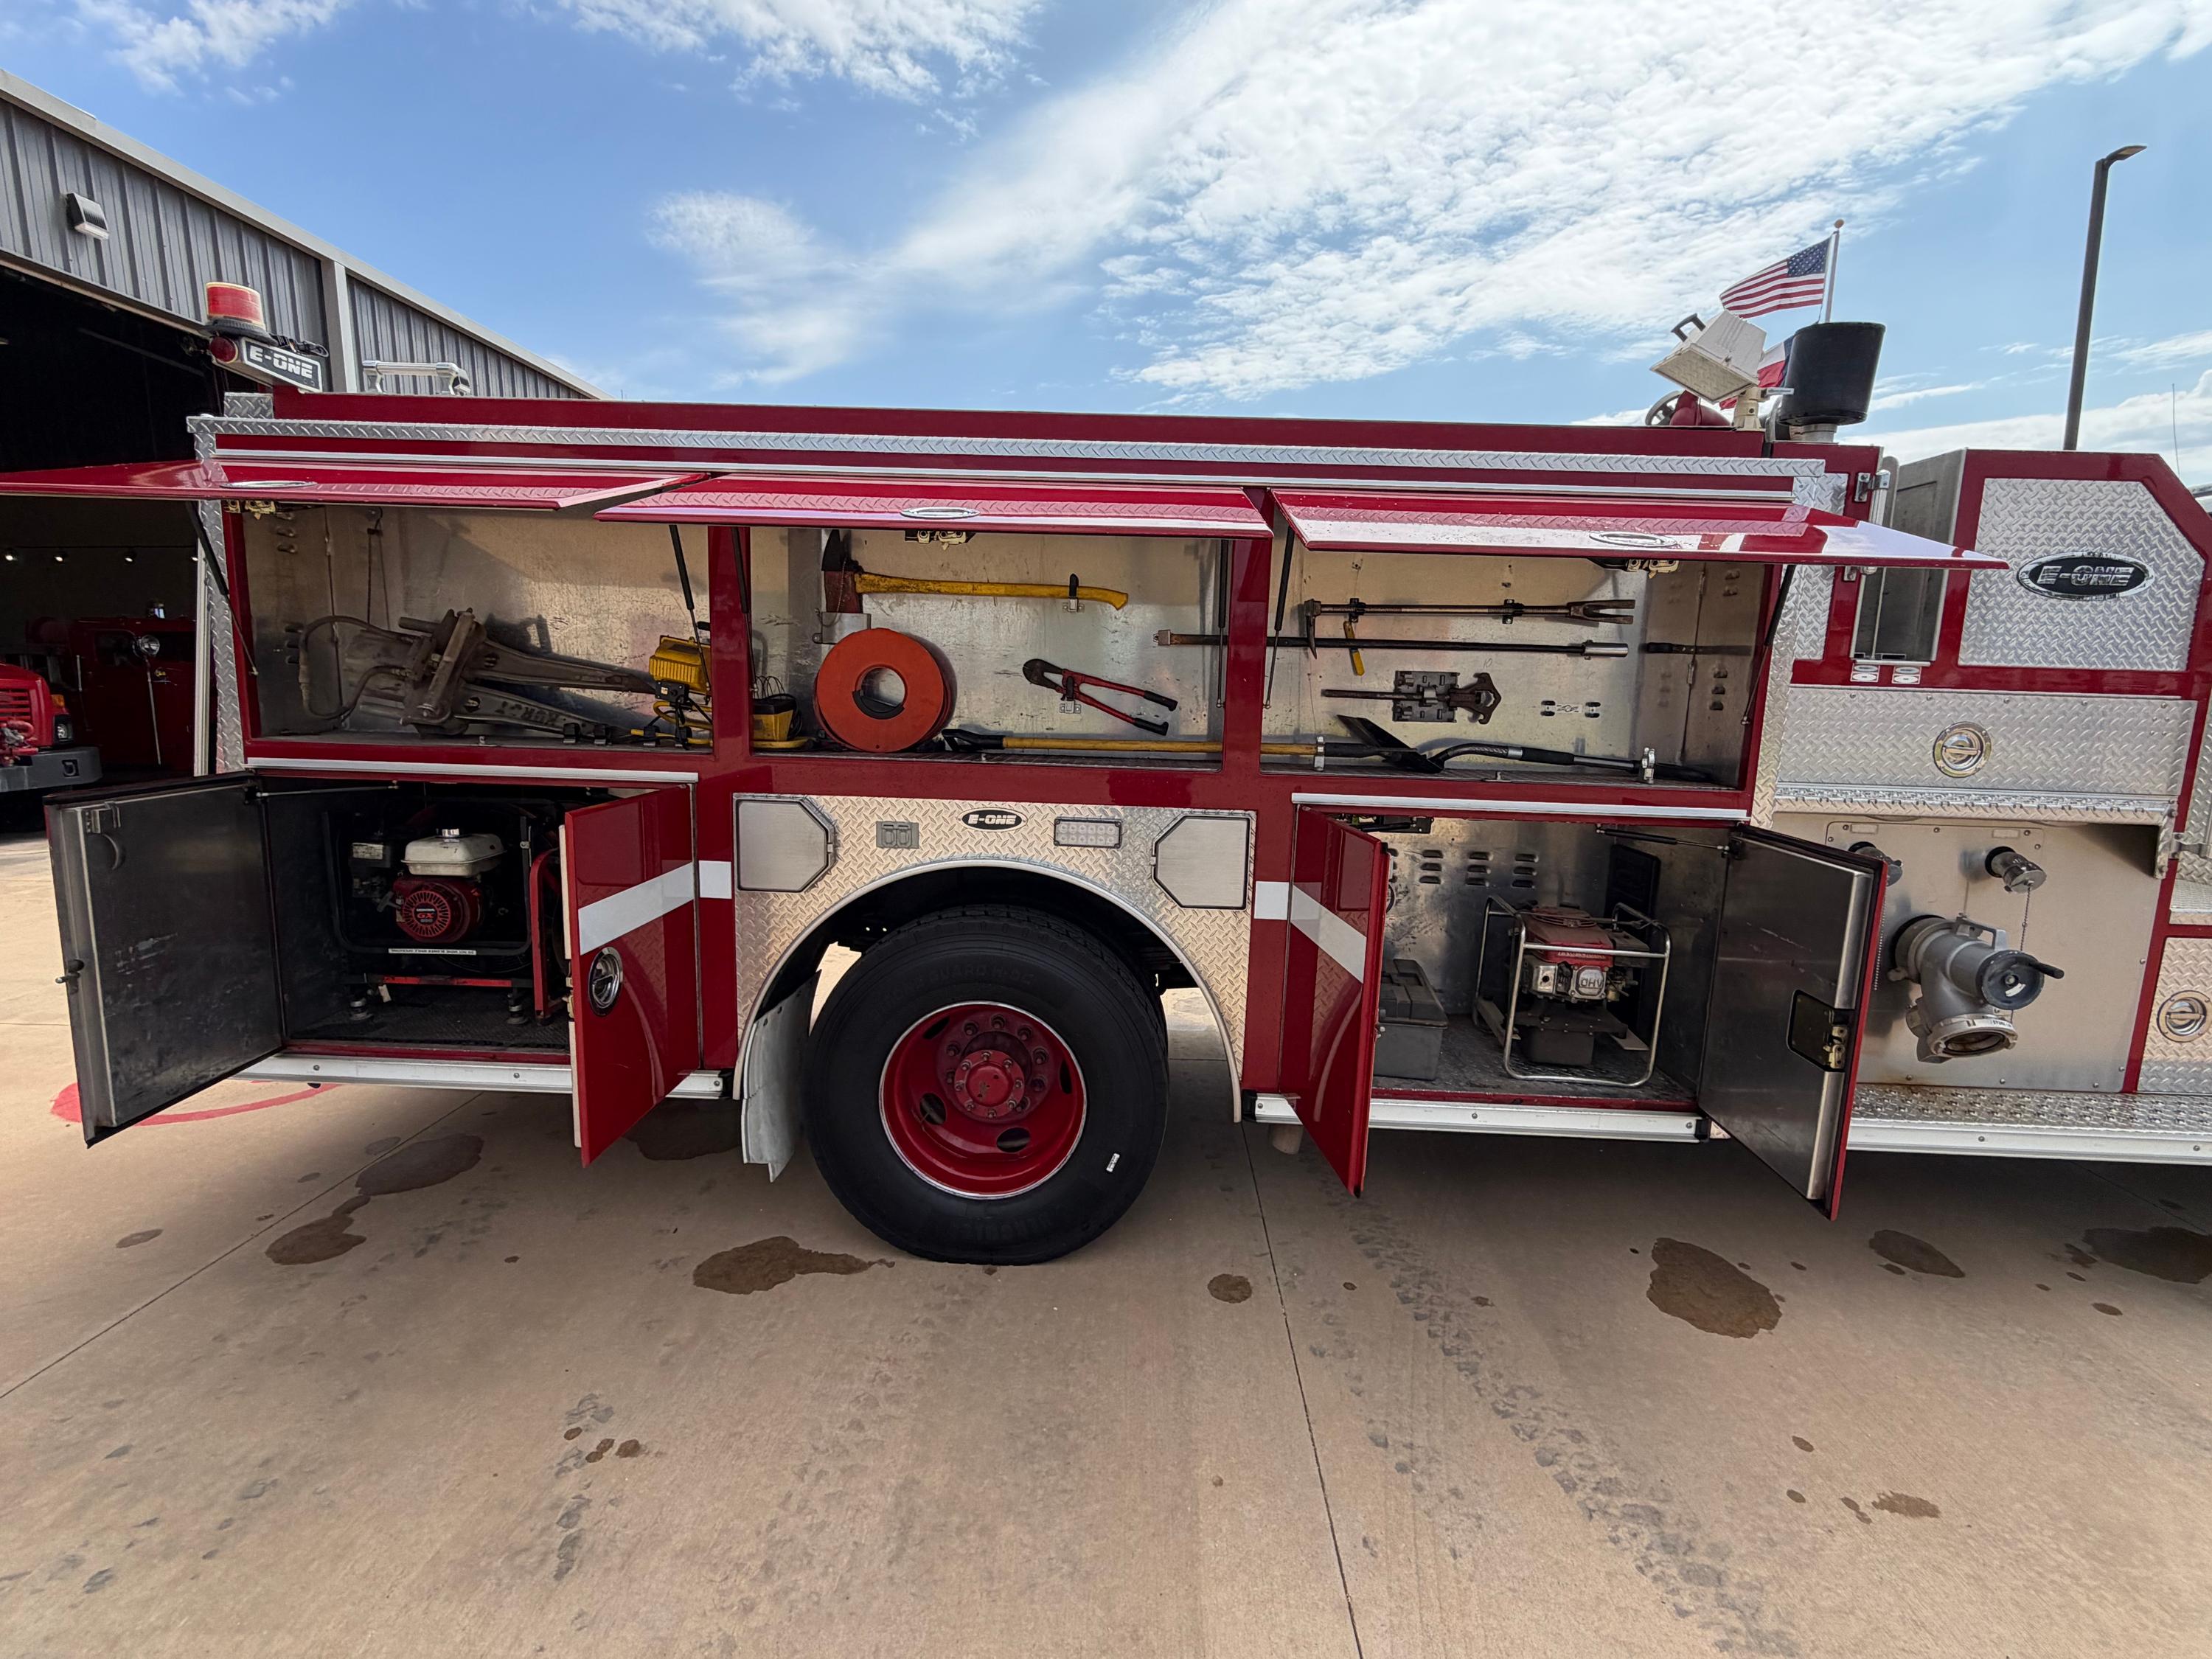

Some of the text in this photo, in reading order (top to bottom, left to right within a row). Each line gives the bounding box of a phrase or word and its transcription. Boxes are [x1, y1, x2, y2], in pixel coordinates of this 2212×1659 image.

[249, 344, 313, 379] E-ONE
[2037, 565, 2135, 586] E-ONE
[967, 814, 1017, 825] E-ONE
[1581, 978, 1604, 987] OHV
